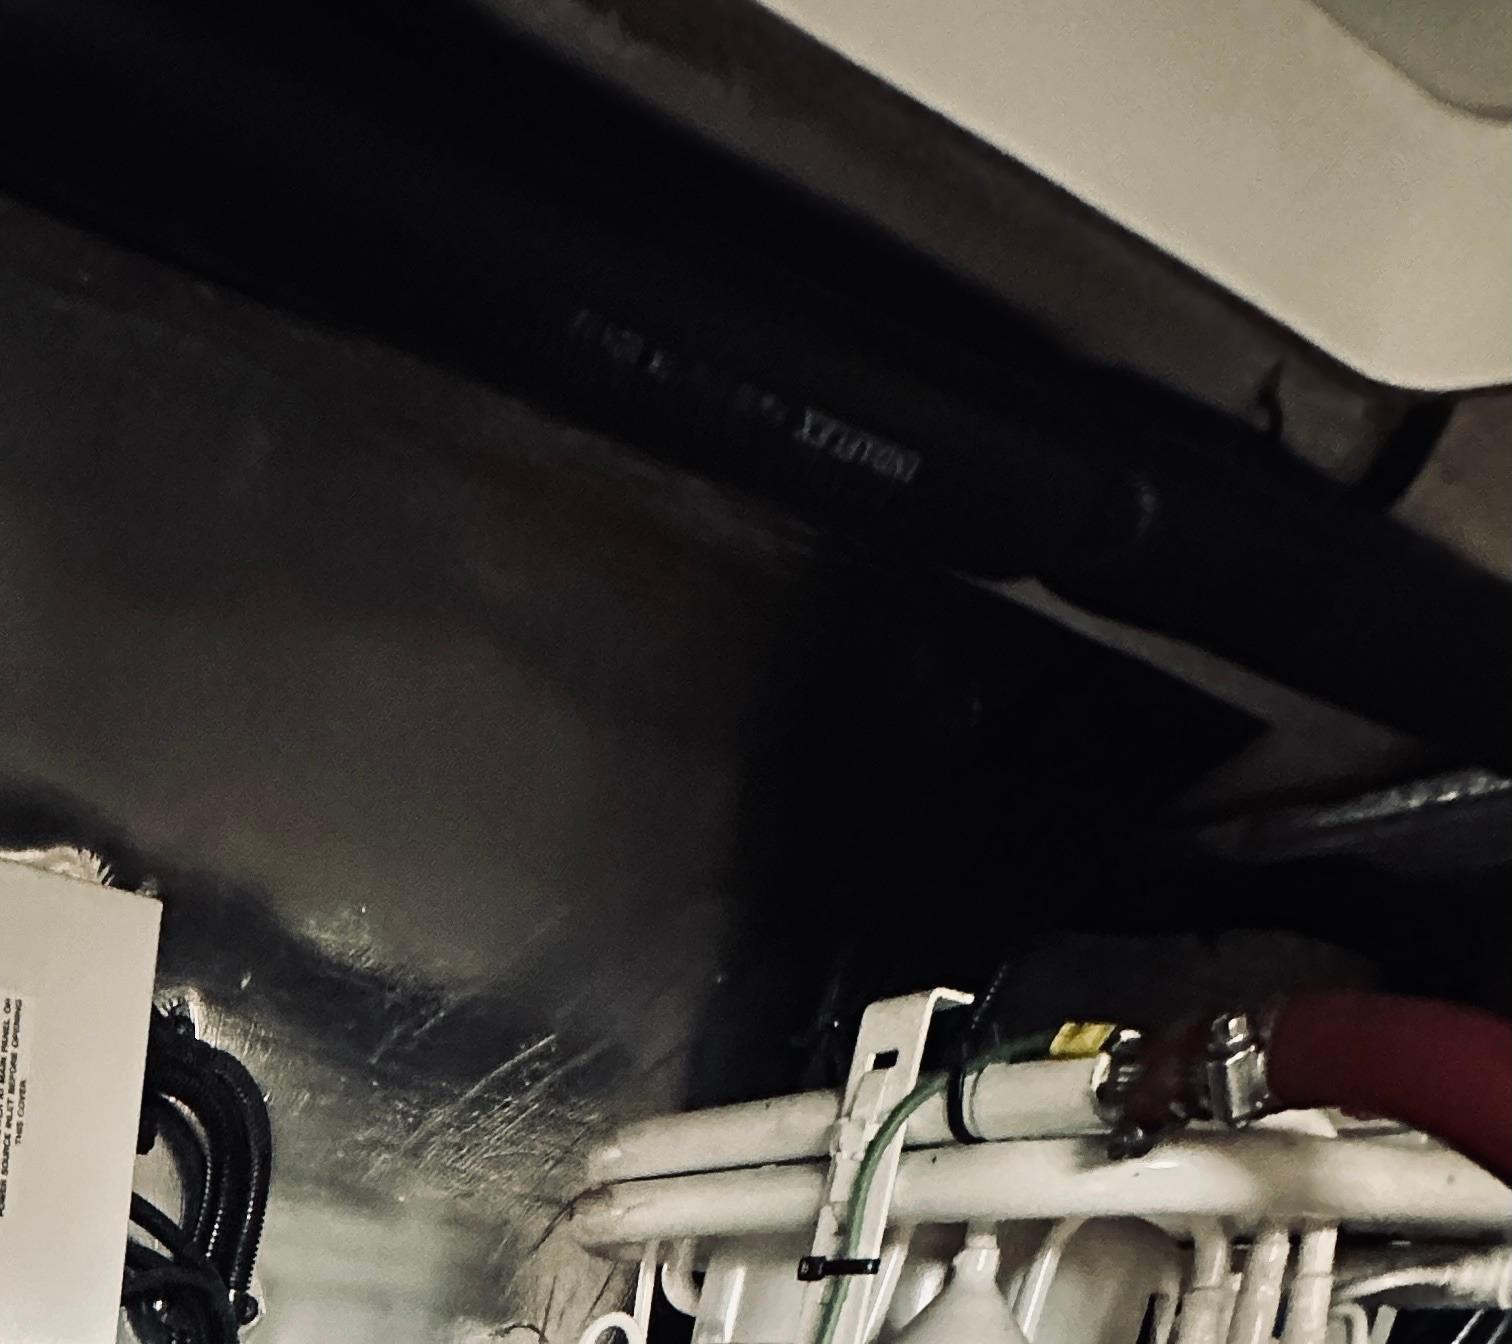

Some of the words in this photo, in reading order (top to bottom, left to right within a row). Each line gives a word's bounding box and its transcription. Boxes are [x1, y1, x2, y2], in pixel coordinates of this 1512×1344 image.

[4, 998, 11, 1014] OR
[1, 1019, 10, 1052] PANEL
[11, 999, 22, 1048] OPENING
[8, 1052, 17, 1094] BEFORE
[5, 1097, 14, 1128] INLET
[15, 1121, 23, 1144] THIS
[1, 1133, 11, 1176] SOURCE
